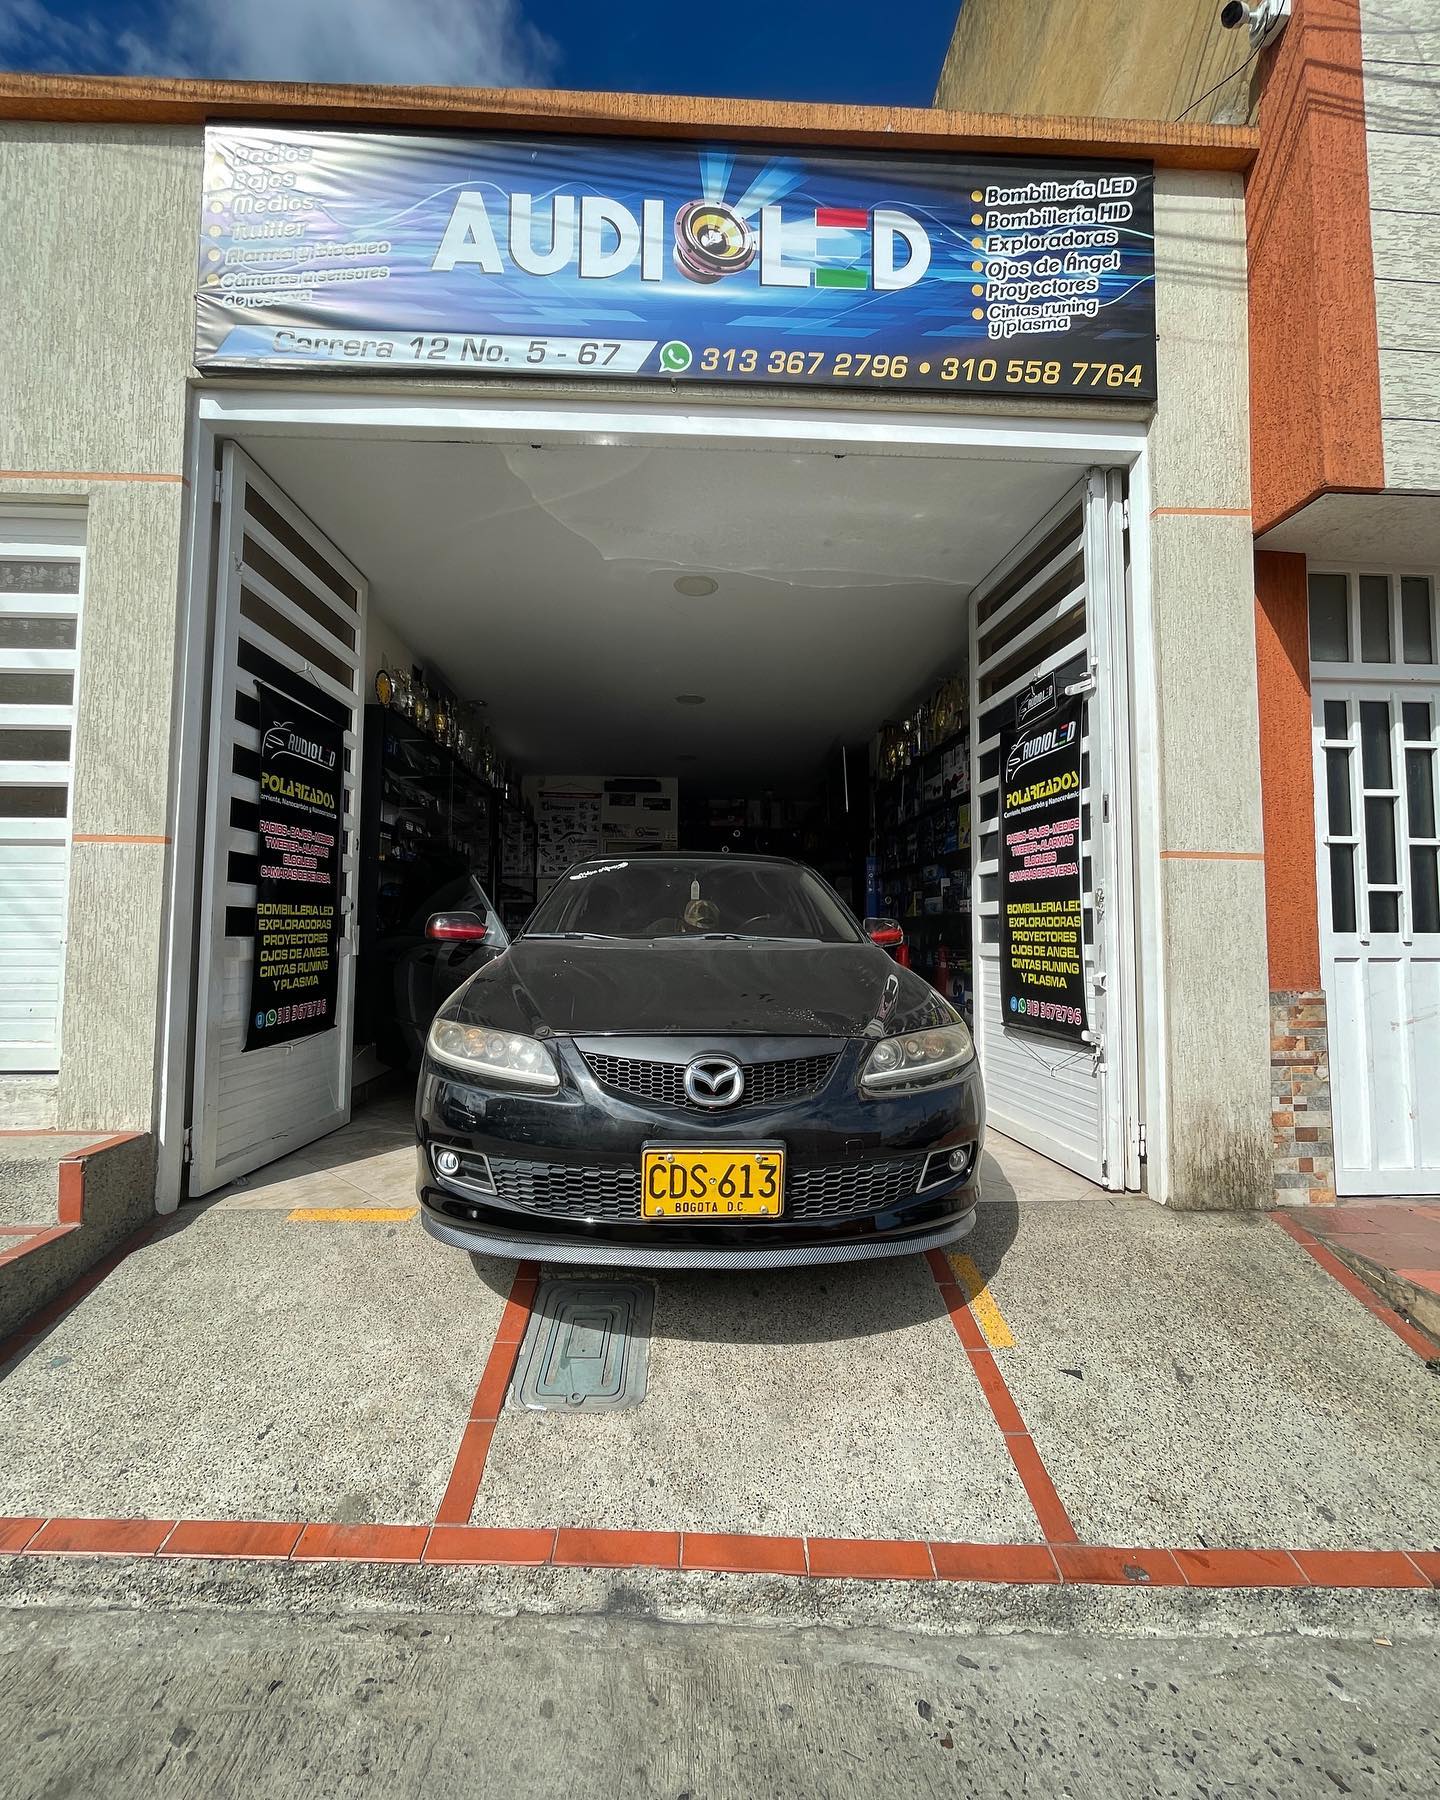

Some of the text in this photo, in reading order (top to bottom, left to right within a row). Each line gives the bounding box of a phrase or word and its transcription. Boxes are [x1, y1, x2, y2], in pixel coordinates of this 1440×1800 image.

[987, 179, 1136, 204] Bombillería LED
[234, 195, 314, 214] Medios
[987, 204, 1132, 229] Bombillería HID
[988, 231, 1117, 255] Exploradoras
[988, 252, 1119, 280] Ojos de Ángel
[988, 279, 1097, 300] Proyectores
[989, 299, 1097, 320] Cintas runing
[990, 316, 1069, 337] y plasma
[272, 330, 394, 358] Carrera
[409, 336, 449, 360] 12
[460, 338, 510, 362] No.
[526, 340, 548, 363] 5
[577, 342, 622, 366] 67
[700, 347, 909, 378] 313 367 2796
[940, 357, 1143, 387] 310 558 7764
[260, 772, 336, 809] POLARIZADOS
[1006, 771, 1079, 809] POLARIZADOS
[256, 903, 334, 916] BOMBILLERIA LED
[1007, 901, 1062, 915] BOMBILLERIA
[257, 919, 332, 931] EXPLORADORAS
[1008, 916, 1081, 928] EXPLORADORAS
[263, 933, 329, 946] PROYECTORES
[1012, 930, 1077, 943] PROYECTORES
[260, 946, 330, 962] OJOS DE ANGEL
[1011, 944, 1079, 959] OJOS DE ANGEL
[259, 960, 328, 978] CINTAS RUNING
[1011, 958, 1080, 975] CINTAS RUNING
[273, 975, 319, 991] Y PLASMA
[1021, 972, 1067, 989] Y PLASMA
[649, 1164, 777, 1199] CDS 613
[675, 1202, 718, 1213] BOGOTA
